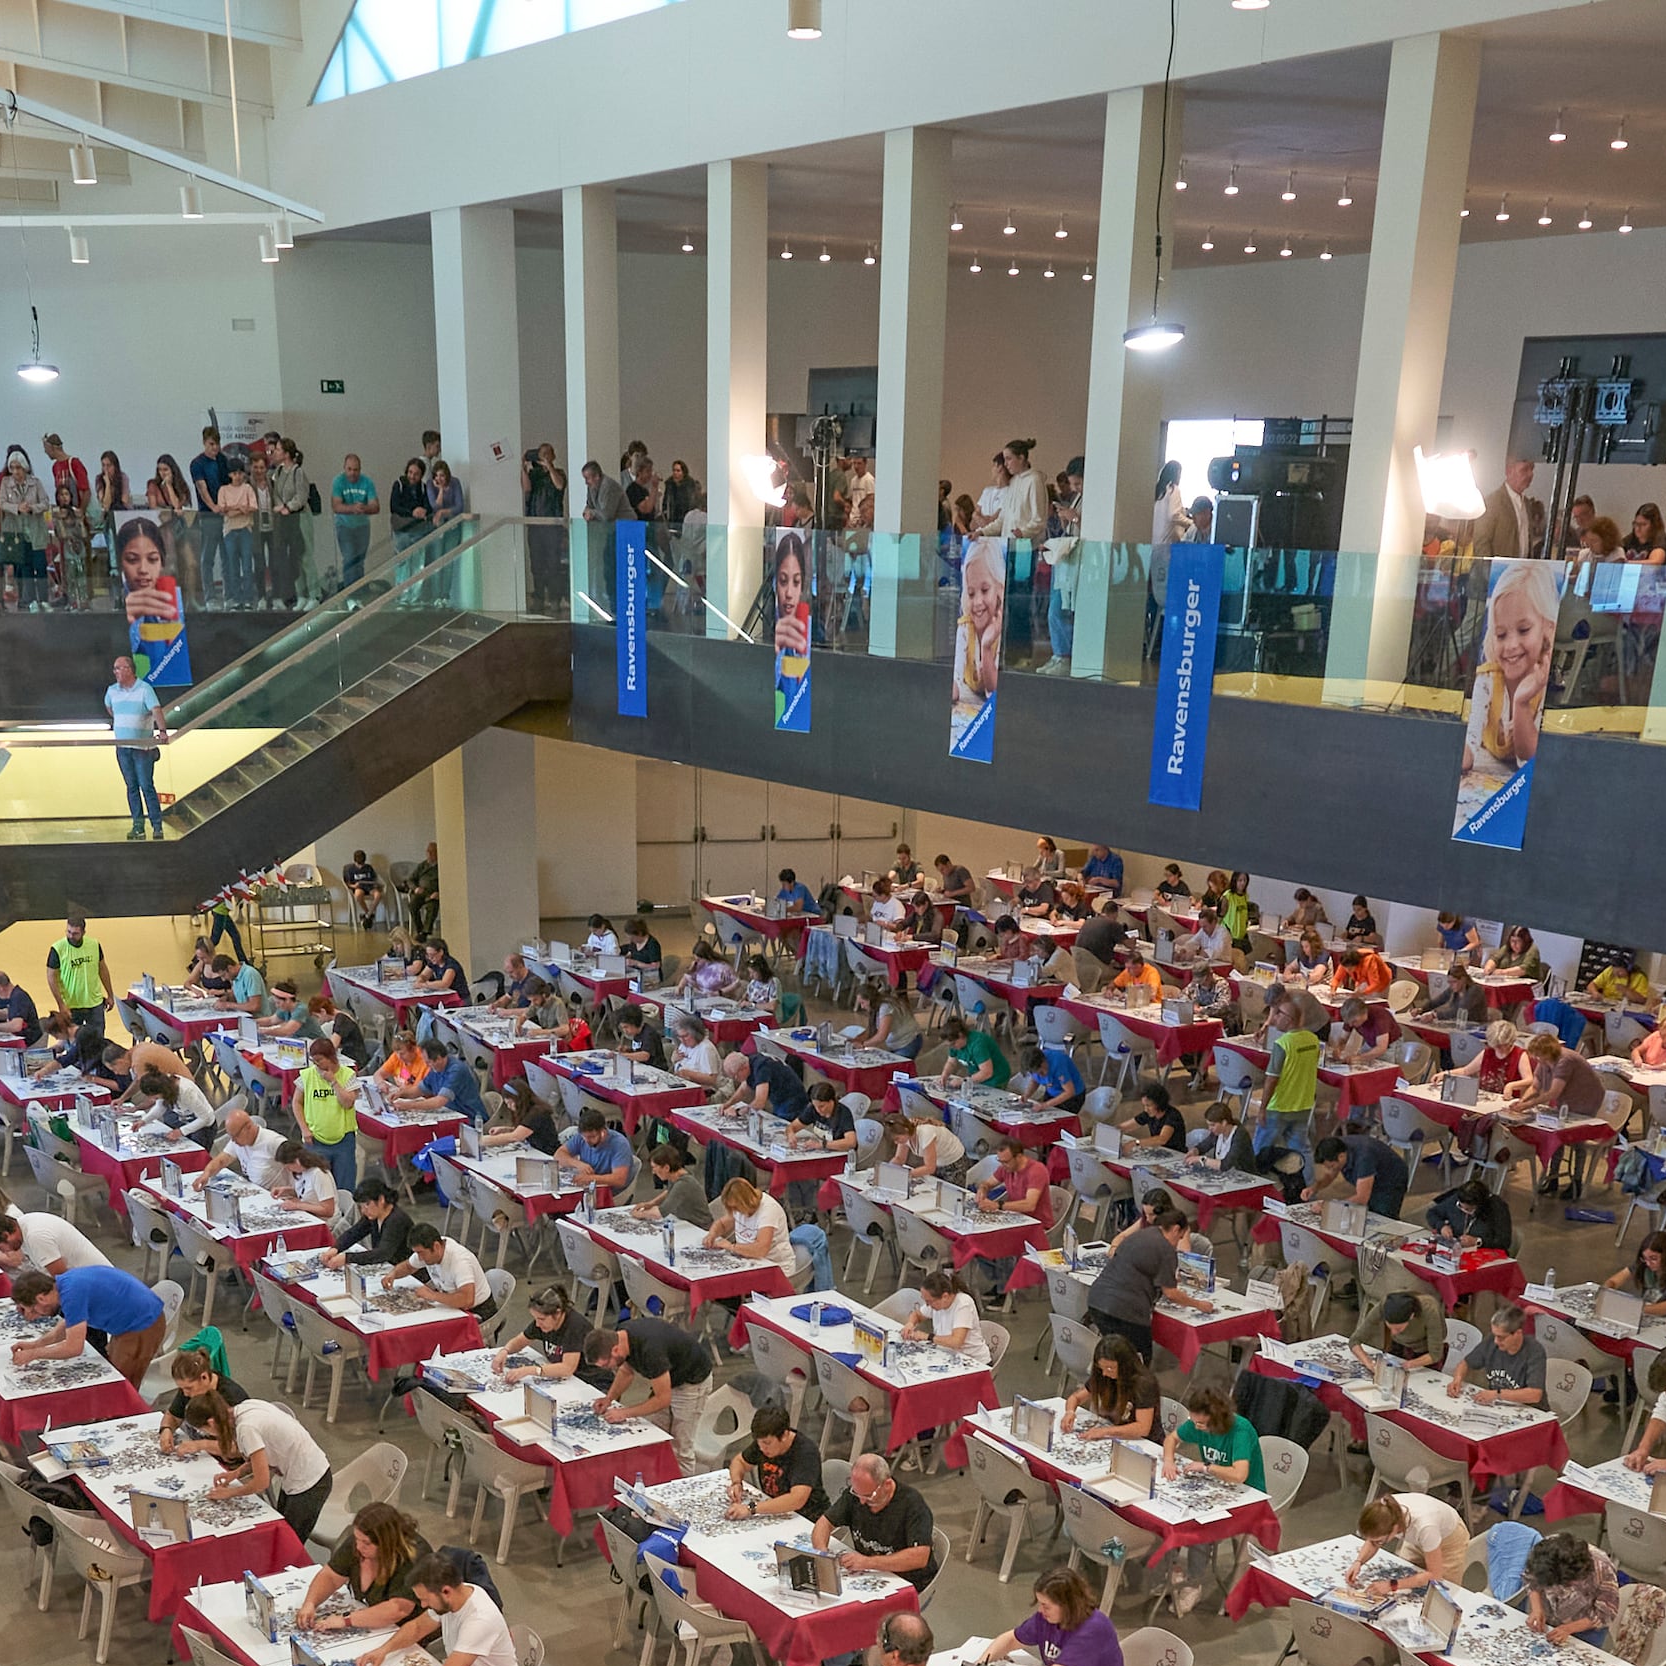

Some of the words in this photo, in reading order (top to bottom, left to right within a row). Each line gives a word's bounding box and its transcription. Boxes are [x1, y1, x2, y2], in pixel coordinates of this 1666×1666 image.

[626, 544, 637, 691] Ravensburger
[147, 639, 183, 682] Ravensburger
[1167, 579, 1202, 774] Ravensburger
[958, 703, 992, 751] Ravensburger
[1468, 774, 1527, 835] Ravensburger
